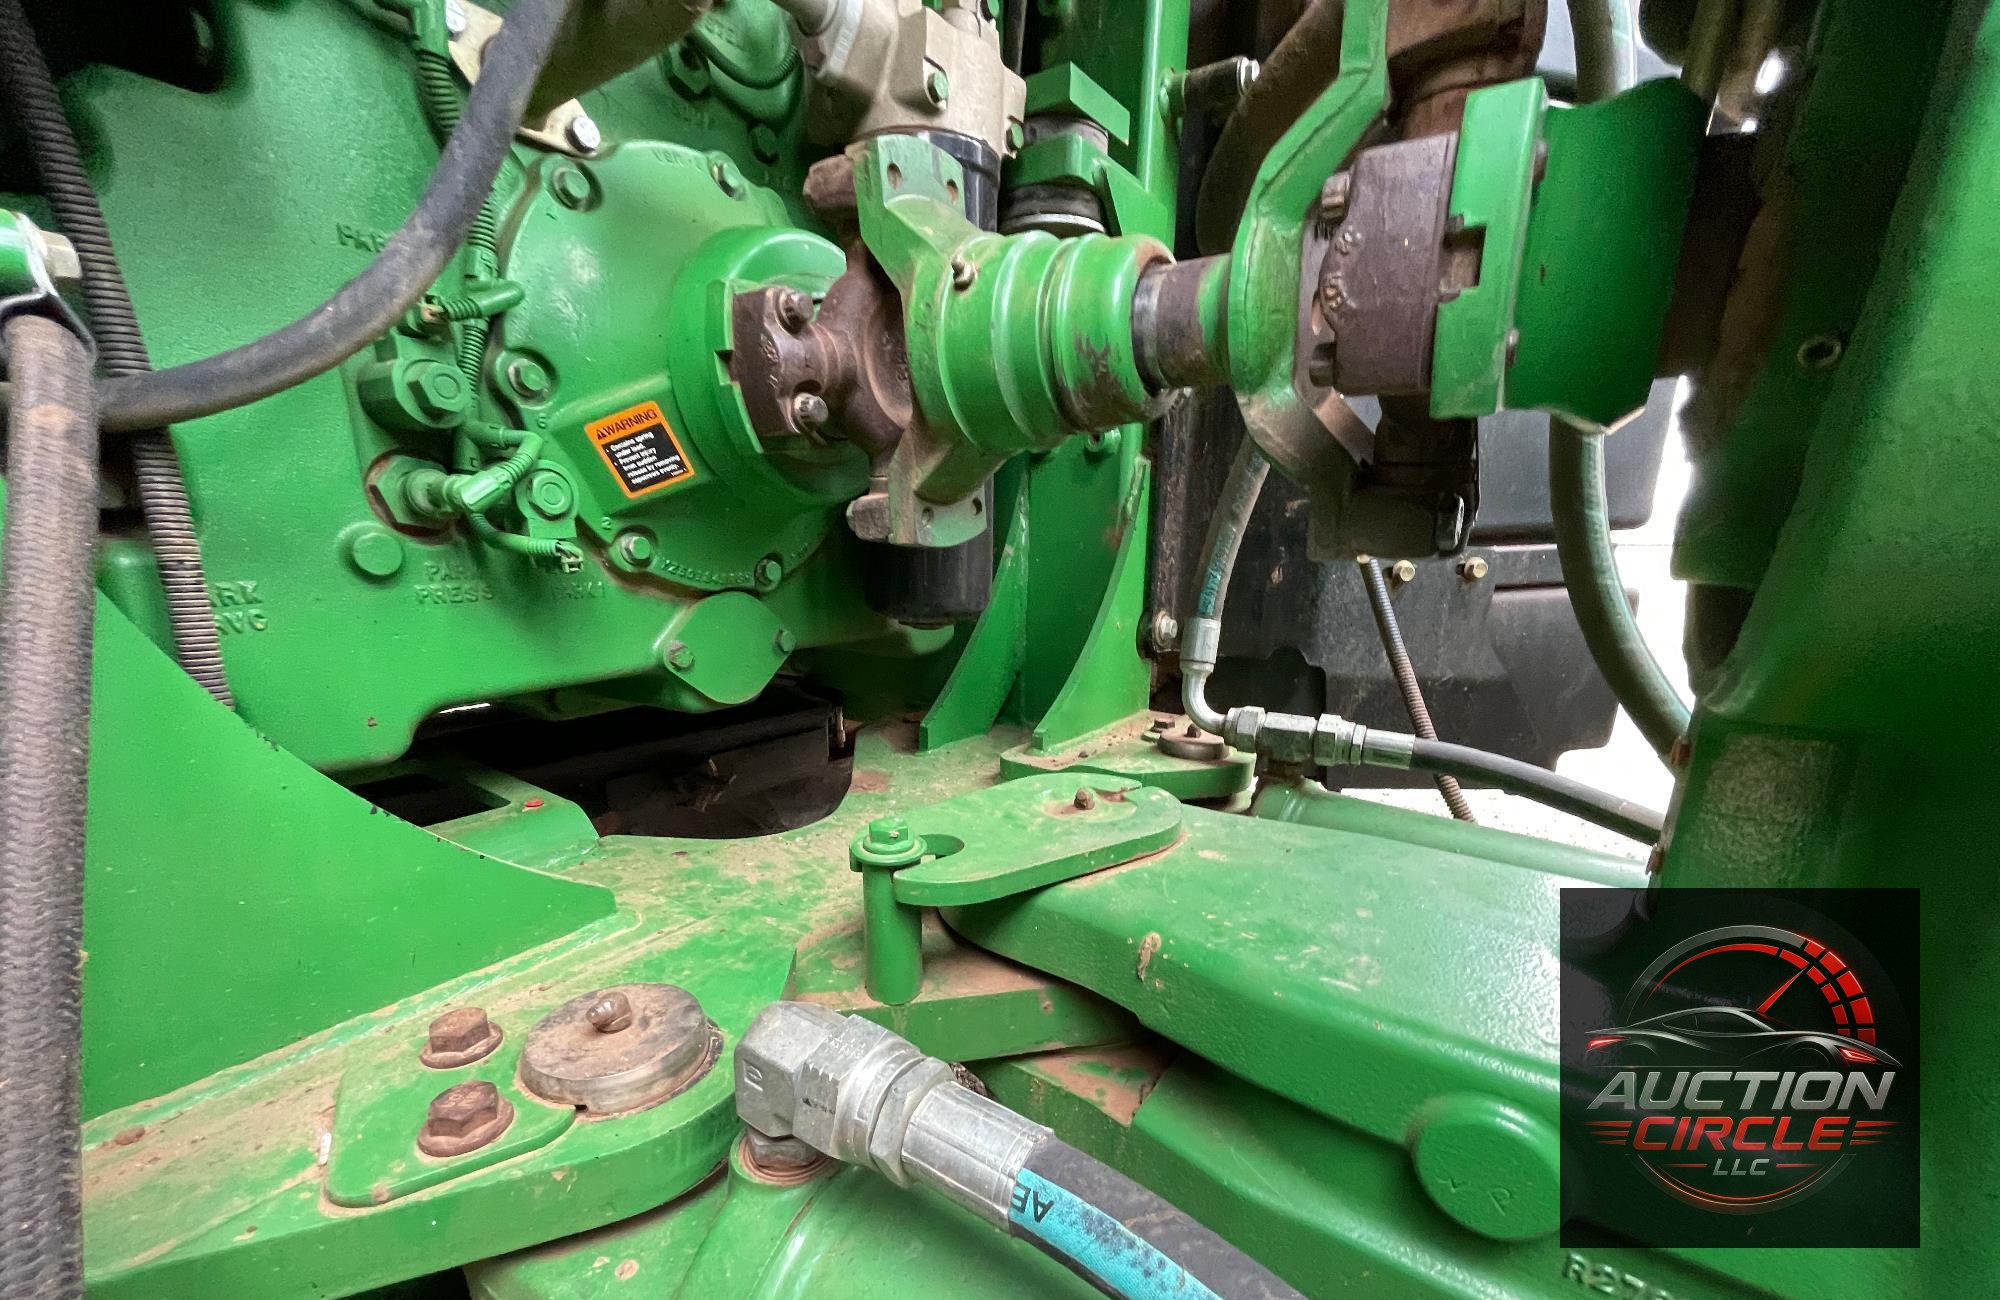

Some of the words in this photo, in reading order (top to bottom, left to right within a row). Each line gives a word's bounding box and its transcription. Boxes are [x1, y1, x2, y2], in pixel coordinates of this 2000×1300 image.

[603, 409, 658, 438] WARNING
[610, 438, 636, 452] Contains
[635, 431, 655, 442] spring
[615, 447, 632, 459] under
[618, 452, 641, 465] Prevent
[640, 447, 657, 458] injury
[622, 461, 638, 472] from
[636, 455, 658, 467] sudden
[627, 467, 648, 478] release
[646, 463, 655, 472] by
[654, 454, 681, 468] removing
